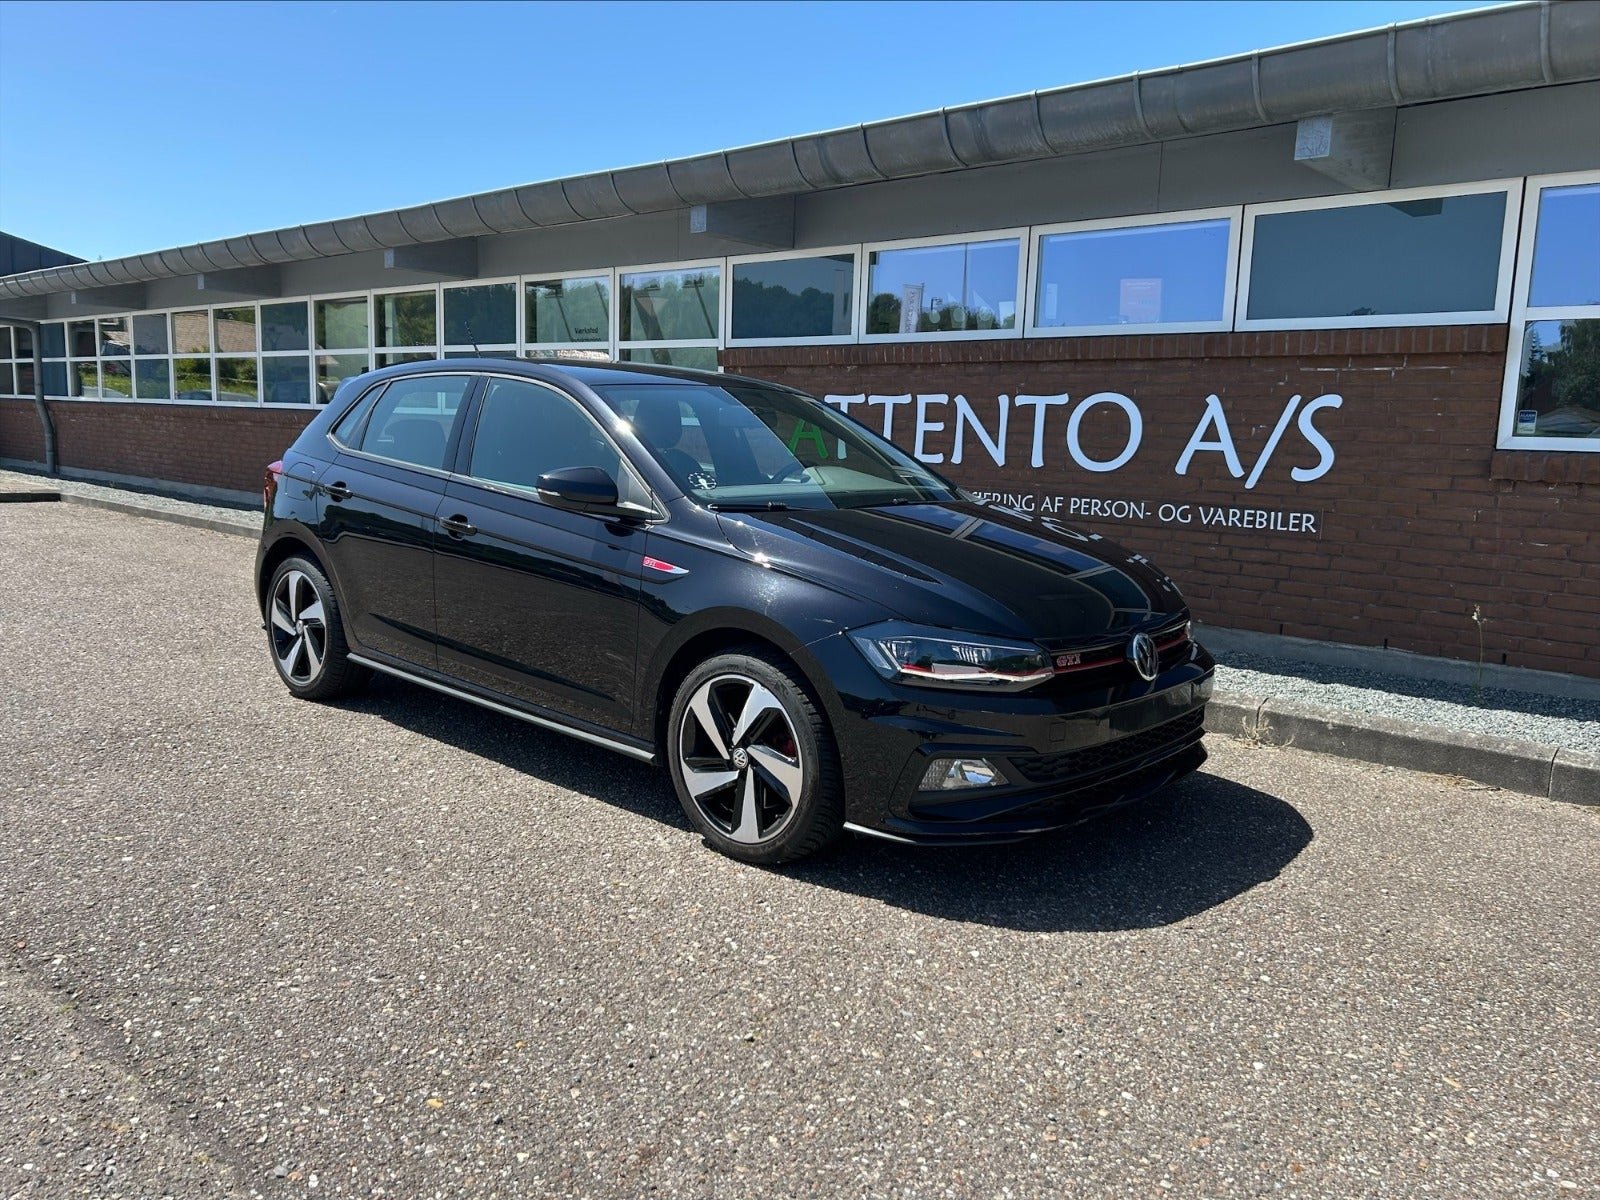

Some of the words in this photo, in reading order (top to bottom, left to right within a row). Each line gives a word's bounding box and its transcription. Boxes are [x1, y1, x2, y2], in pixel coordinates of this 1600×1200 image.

[788, 392, 1143, 473] ATTENTO
[1175, 393, 1343, 489] A/S
[1040, 496, 1064, 513] AF
[1069, 497, 1153, 519] PERSON-
[1158, 503, 1192, 524] OG
[1199, 506, 1317, 534] VAREBILER
[1056, 653, 1081, 667] GTI
